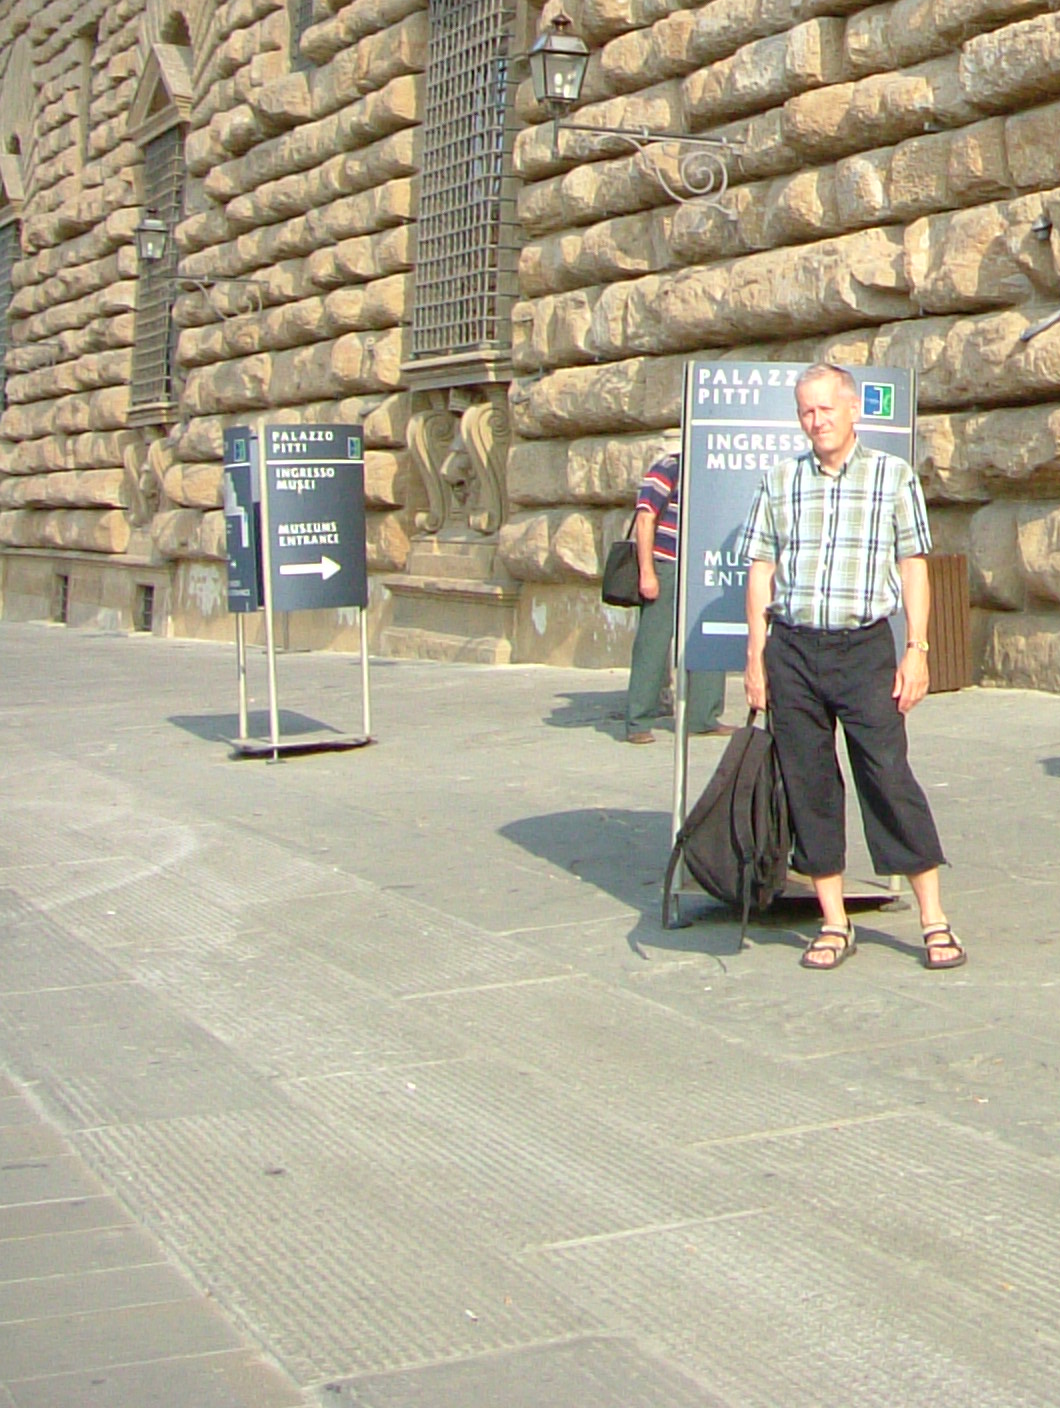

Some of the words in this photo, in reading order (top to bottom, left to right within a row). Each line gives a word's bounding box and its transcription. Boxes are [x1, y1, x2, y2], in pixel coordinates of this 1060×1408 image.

[699, 368, 798, 386] PALAZZ
[698, 388, 760, 405] PITTI
[272, 431, 334, 441] PALAZZO
[273, 443, 307, 453] PITTI
[276, 467, 335, 478] INGRESSO
[276, 479, 316, 490] MUSEI
[279, 533, 339, 547] ENTRANCE
